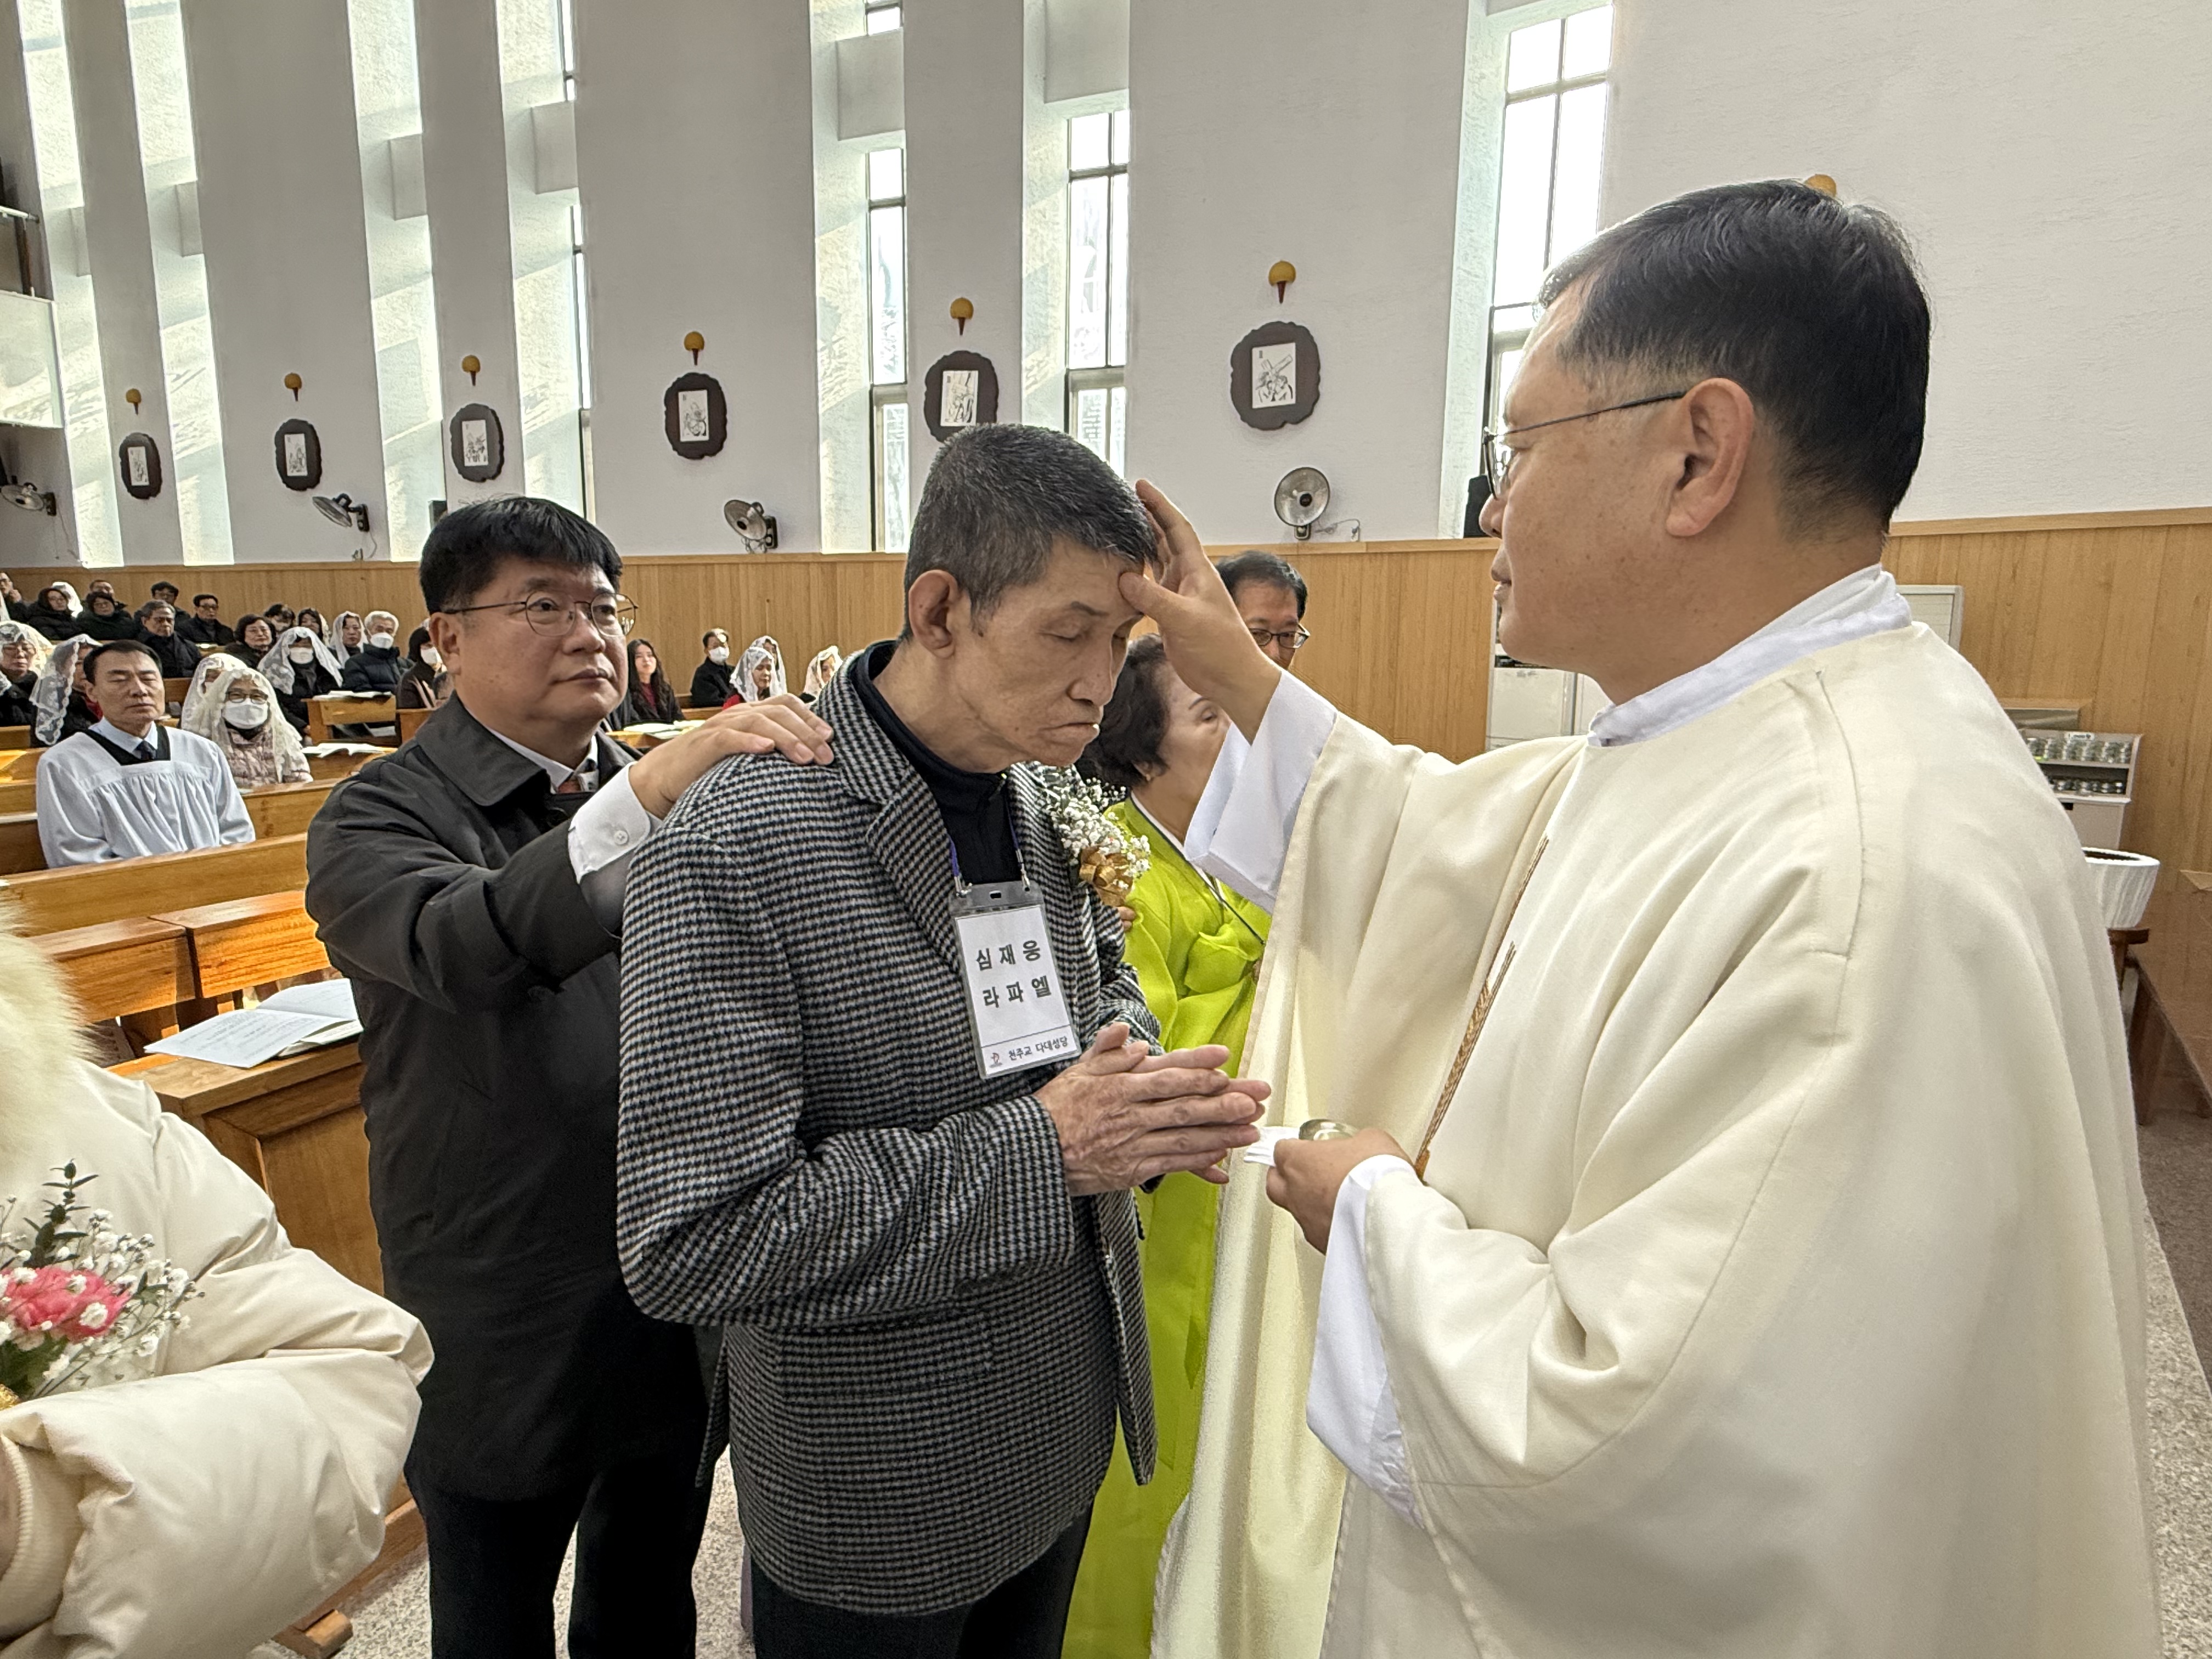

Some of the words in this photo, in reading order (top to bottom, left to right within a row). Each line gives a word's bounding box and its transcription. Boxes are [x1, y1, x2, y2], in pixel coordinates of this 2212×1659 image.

[983, 975, 1051, 1008] 라파엘
[1008, 1046, 1032, 1061] 천주교
[1035, 1036, 1068, 1053] 다대성당
